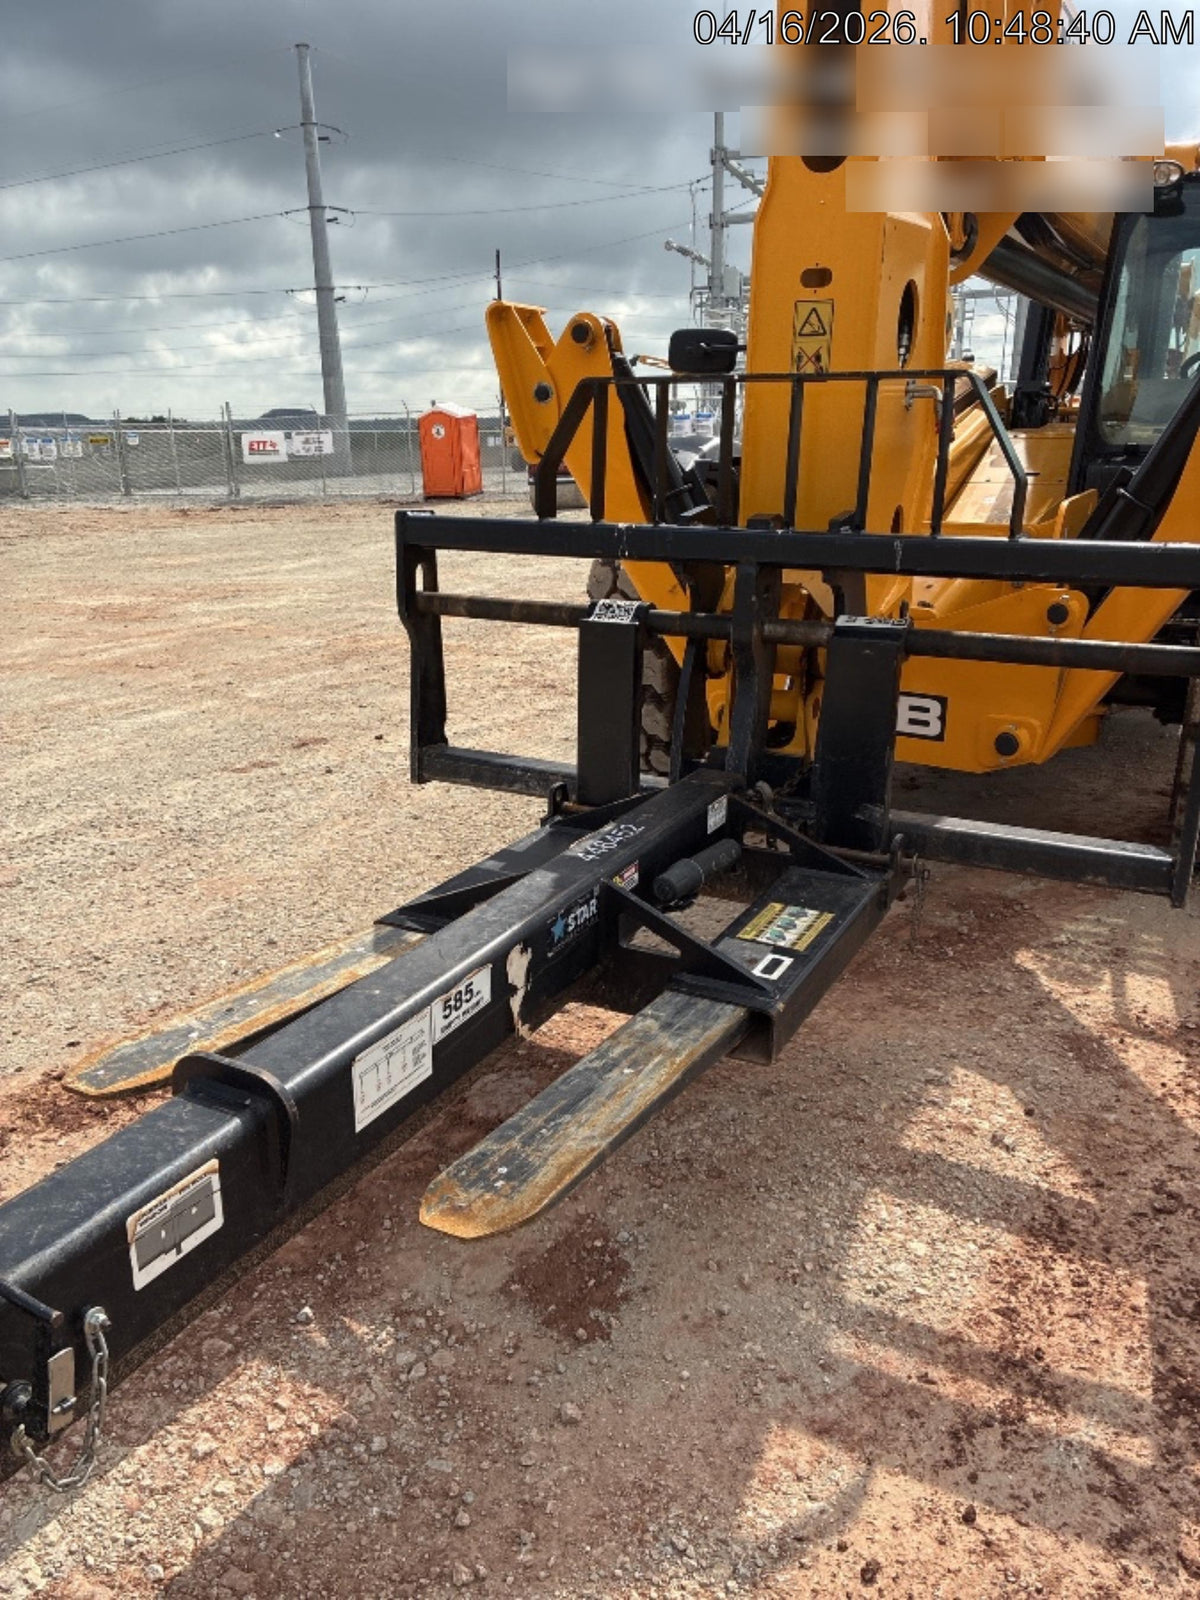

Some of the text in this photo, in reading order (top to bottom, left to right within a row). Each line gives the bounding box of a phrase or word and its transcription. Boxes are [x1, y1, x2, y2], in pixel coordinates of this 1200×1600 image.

[248, 440, 268, 451] ETT
[567, 899, 598, 932] STAR
[443, 981, 474, 1019] 585
